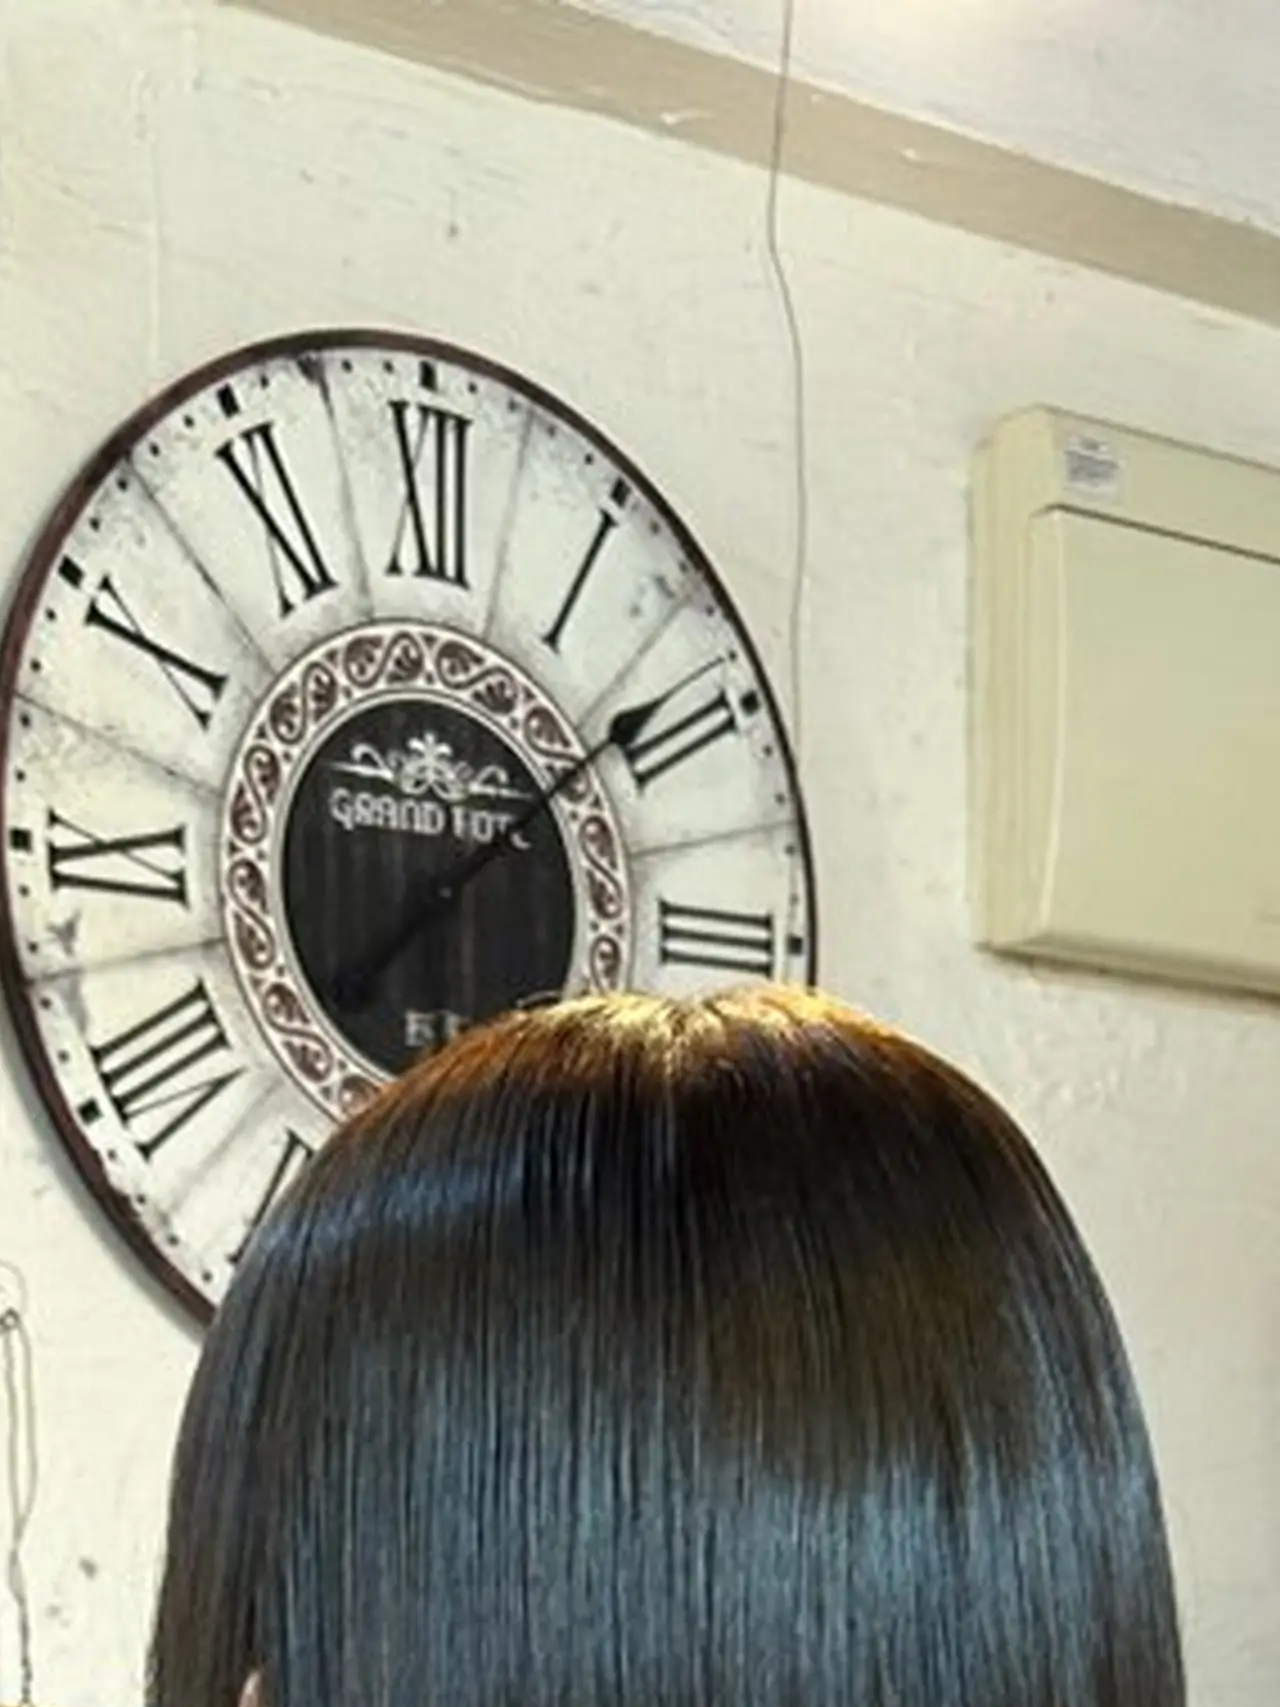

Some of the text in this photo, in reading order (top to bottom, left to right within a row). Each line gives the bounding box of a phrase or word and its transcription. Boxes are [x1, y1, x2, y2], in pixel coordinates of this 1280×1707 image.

[215, 419, 338, 617] XI
[385, 400, 473, 590] XII
[85, 573, 227, 731] X
[542, 508, 618, 655] I
[47, 808, 190, 910] IX
[330, 789, 445, 835] GRAND
[658, 896, 774, 981] III
[90, 980, 246, 1163] VIII
